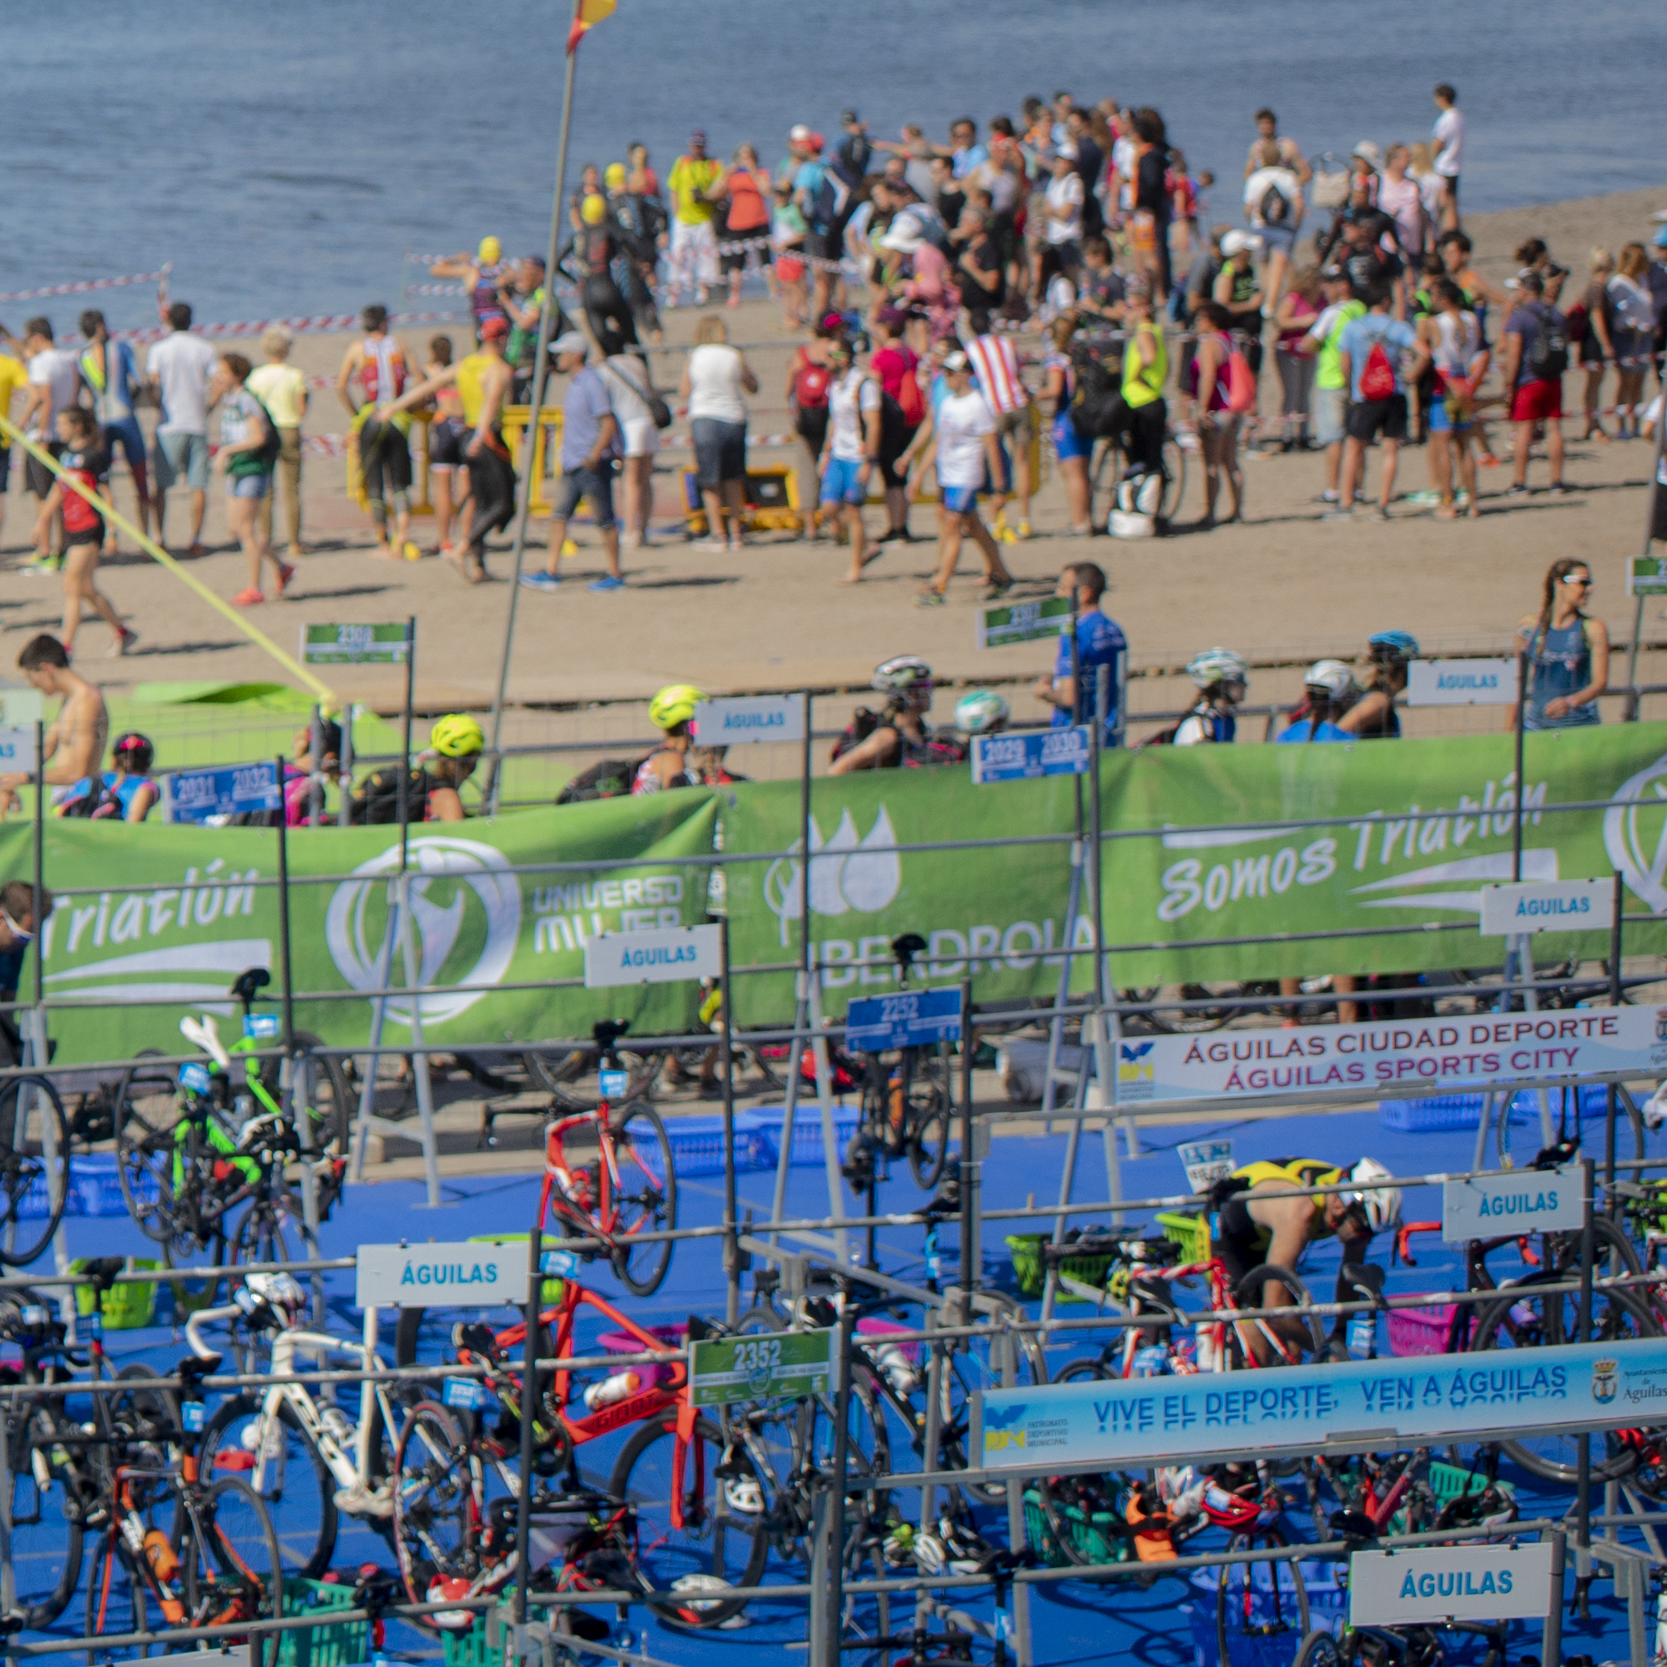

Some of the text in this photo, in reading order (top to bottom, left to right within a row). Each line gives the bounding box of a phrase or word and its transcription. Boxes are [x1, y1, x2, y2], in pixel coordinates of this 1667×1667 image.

[1437, 673, 1498, 690] ÁGUILAS
[723, 711, 785, 730] ÁGUILAS
[1349, 771, 1547, 872] Triatlón
[534, 875, 683, 913] UNIVERSO
[1516, 896, 1591, 917] ÁGUILAS
[620, 945, 697, 968] ÁGUILAS
[882, 997, 919, 1021] 2252
[1184, 1015, 1618, 1064] ÁGUILAS CIUDAD DEPORTE
[1223, 1046, 1580, 1091] ÁGUILAS SPORTS CITY
[1478, 1190, 1559, 1218] ÁGUILAS
[401, 1261, 498, 1286] ÁGUILAS
[734, 1340, 782, 1371] 2352
[1093, 1366, 1567, 1423] VIVE EL DEPORTE, VEN A ÁGUILAS
[1623, 1384, 1667, 1403] Águilas
[1399, 1568, 1513, 1599] ÁGUILAS
